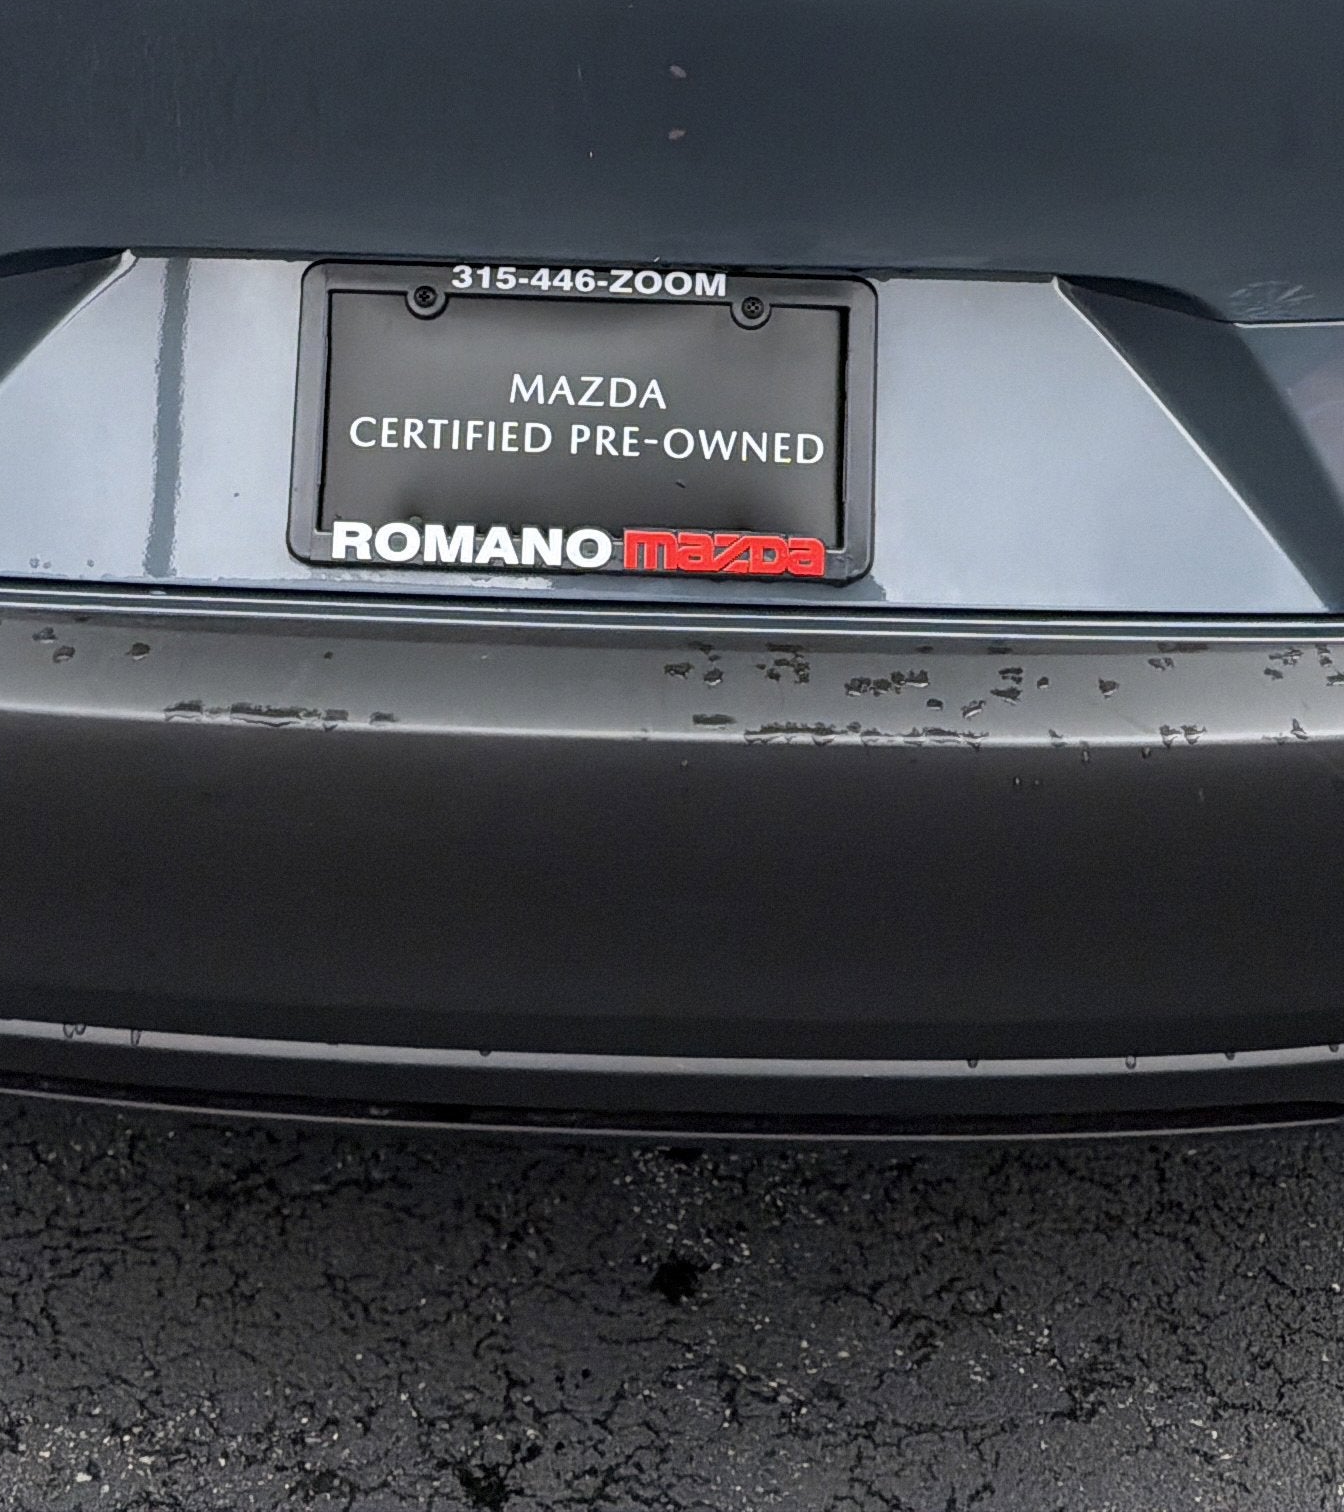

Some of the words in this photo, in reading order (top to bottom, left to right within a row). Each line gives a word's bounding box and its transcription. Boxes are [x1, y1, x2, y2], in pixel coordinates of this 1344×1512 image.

[451, 264, 728, 298] 315-446-ZOOM
[508, 373, 668, 410] MAZDA
[349, 416, 553, 454] CERTIFIED
[570, 424, 826, 466] PRE-OWNED
[330, 520, 614, 570] ROMANO
